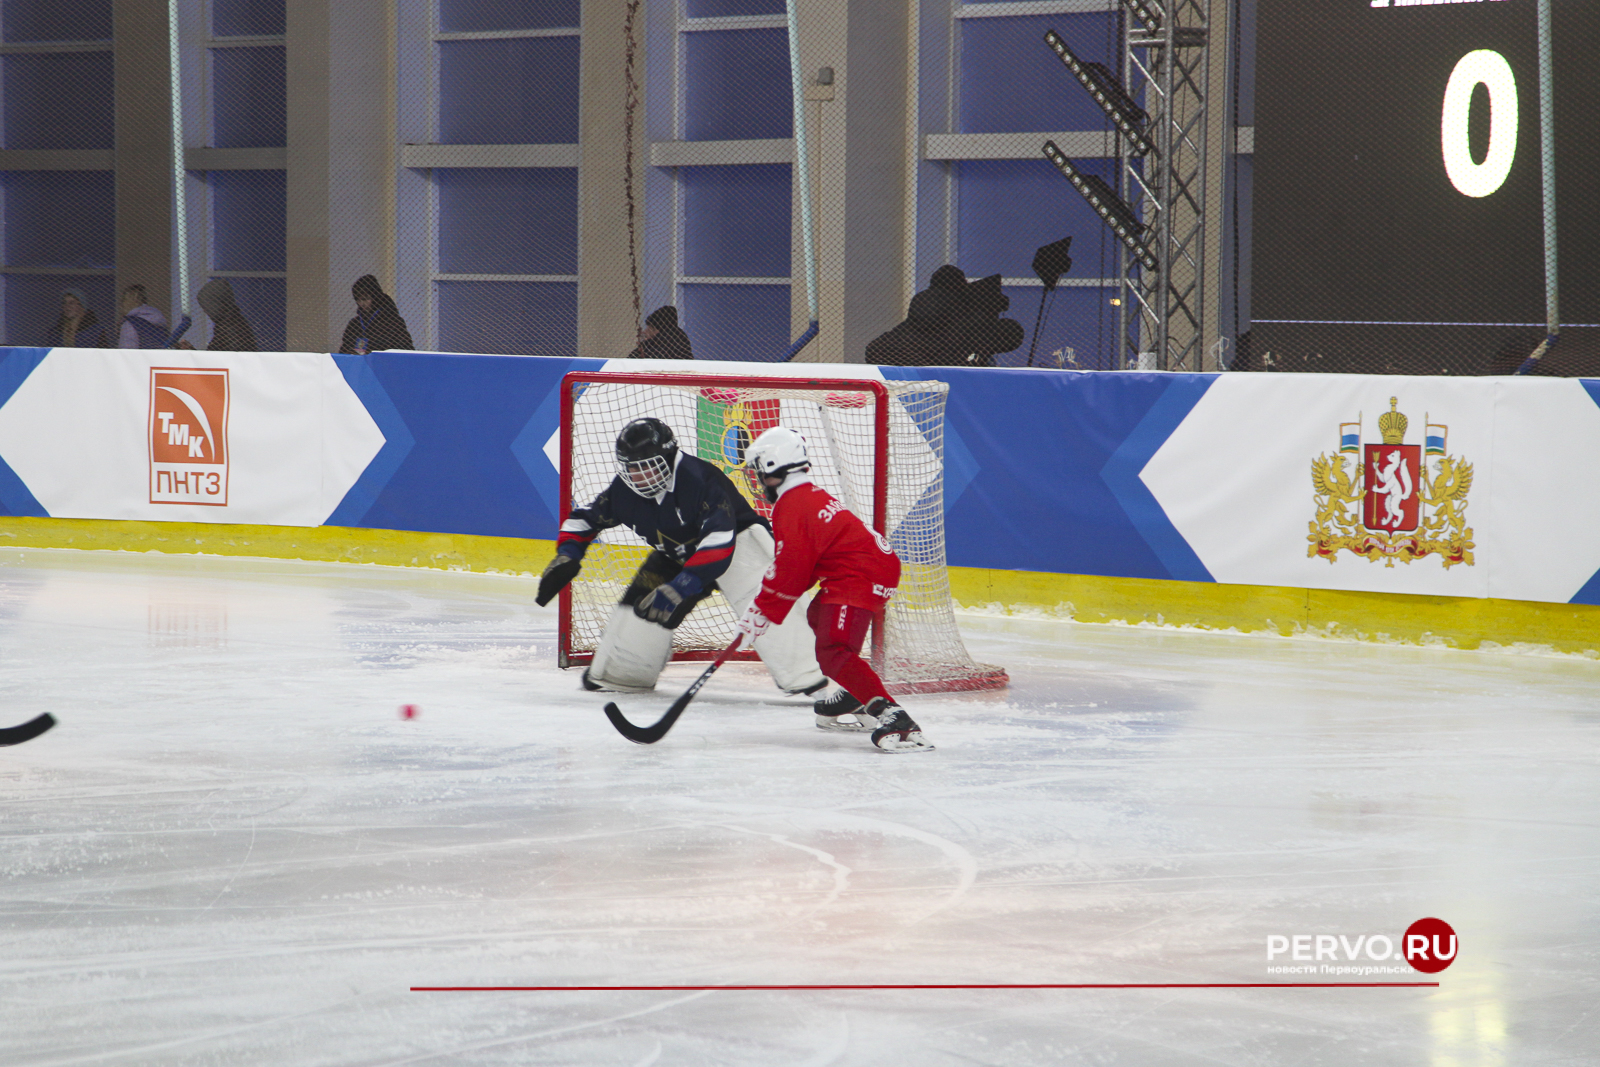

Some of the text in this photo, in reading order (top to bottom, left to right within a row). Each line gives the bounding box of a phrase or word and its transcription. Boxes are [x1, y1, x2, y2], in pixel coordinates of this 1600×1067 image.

[1441, 48, 1519, 198] 0
[158, 411, 205, 458] ТМК
[157, 470, 221, 496] ПНТЗ
